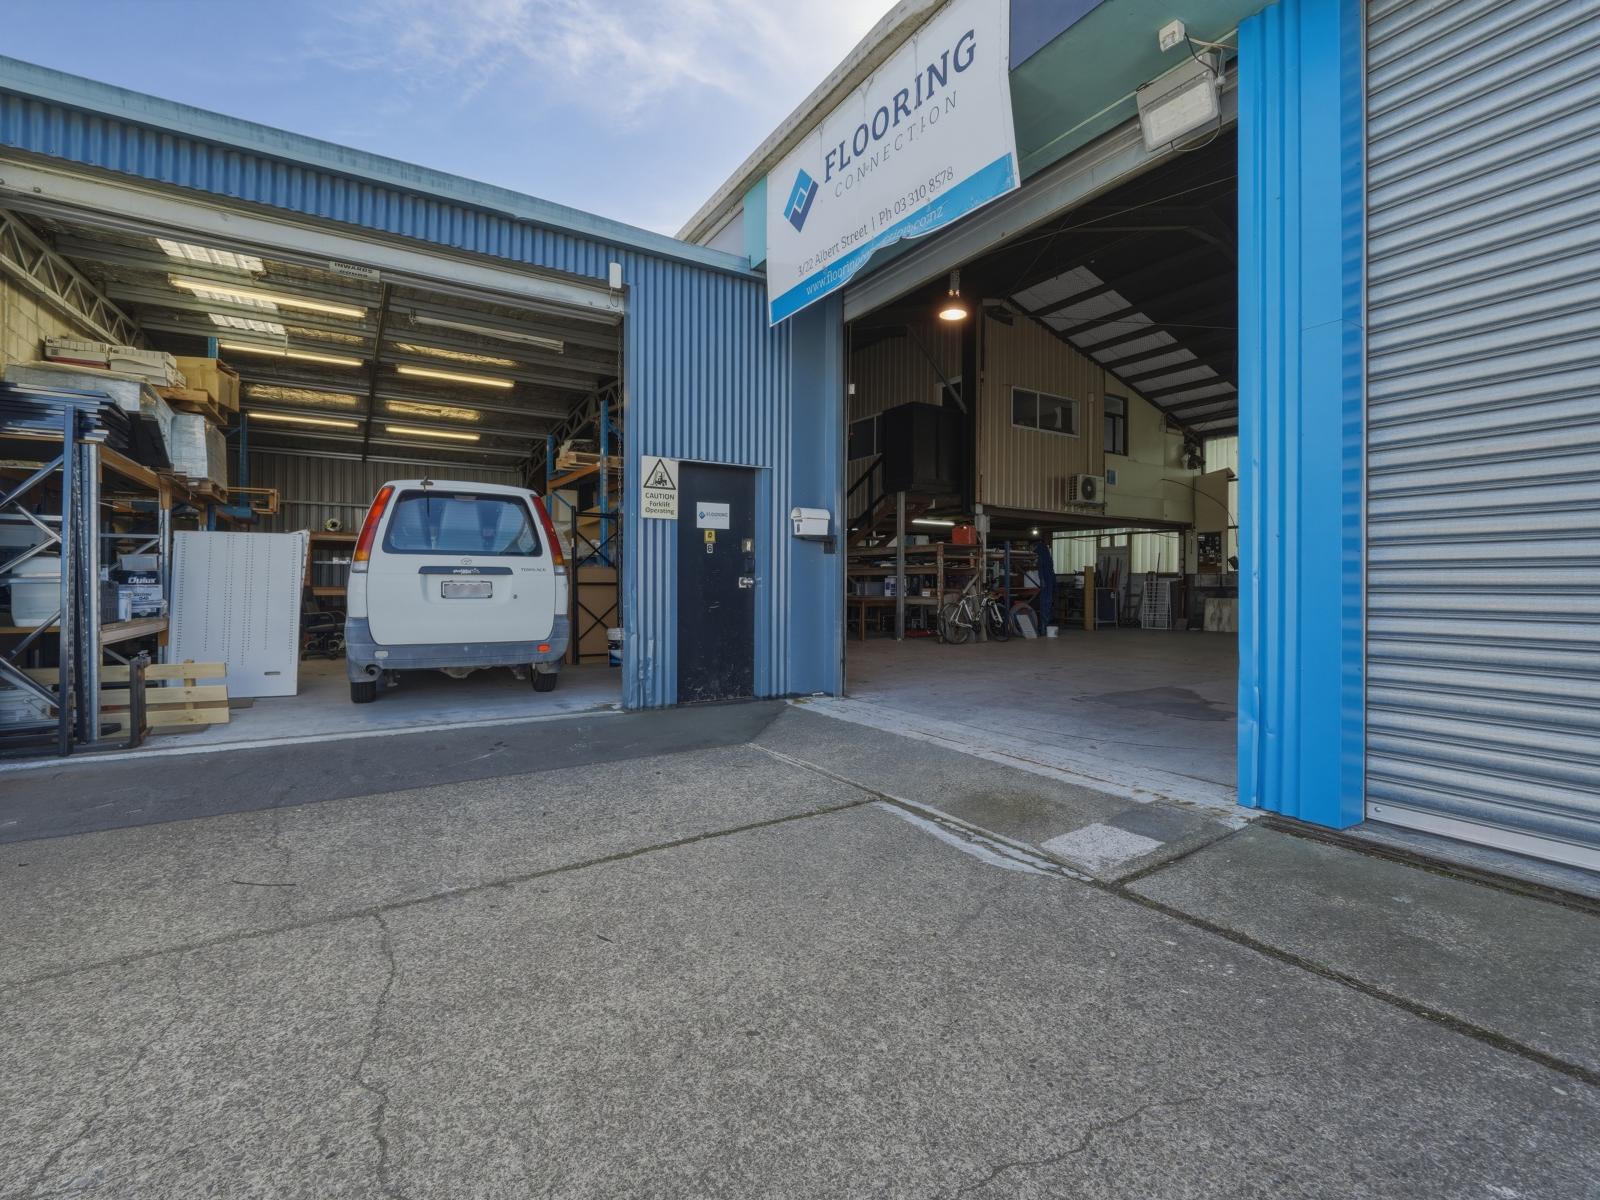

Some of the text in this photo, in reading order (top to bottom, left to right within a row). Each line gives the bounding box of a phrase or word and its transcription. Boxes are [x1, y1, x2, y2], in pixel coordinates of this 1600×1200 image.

[824, 29, 976, 183] FLOORING
[834, 91, 956, 197] CONNECTION
[815, 243, 840, 266] Albert
[841, 224, 868, 249] Street
[879, 207, 892, 225] Ph
[894, 197, 907, 215] 03
[908, 184, 926, 206] 310
[928, 166, 954, 193] 8578
[645, 492, 675, 500] CAUTION
[645, 506, 675, 515] Operating
[127, 576, 156, 584] Dulux
